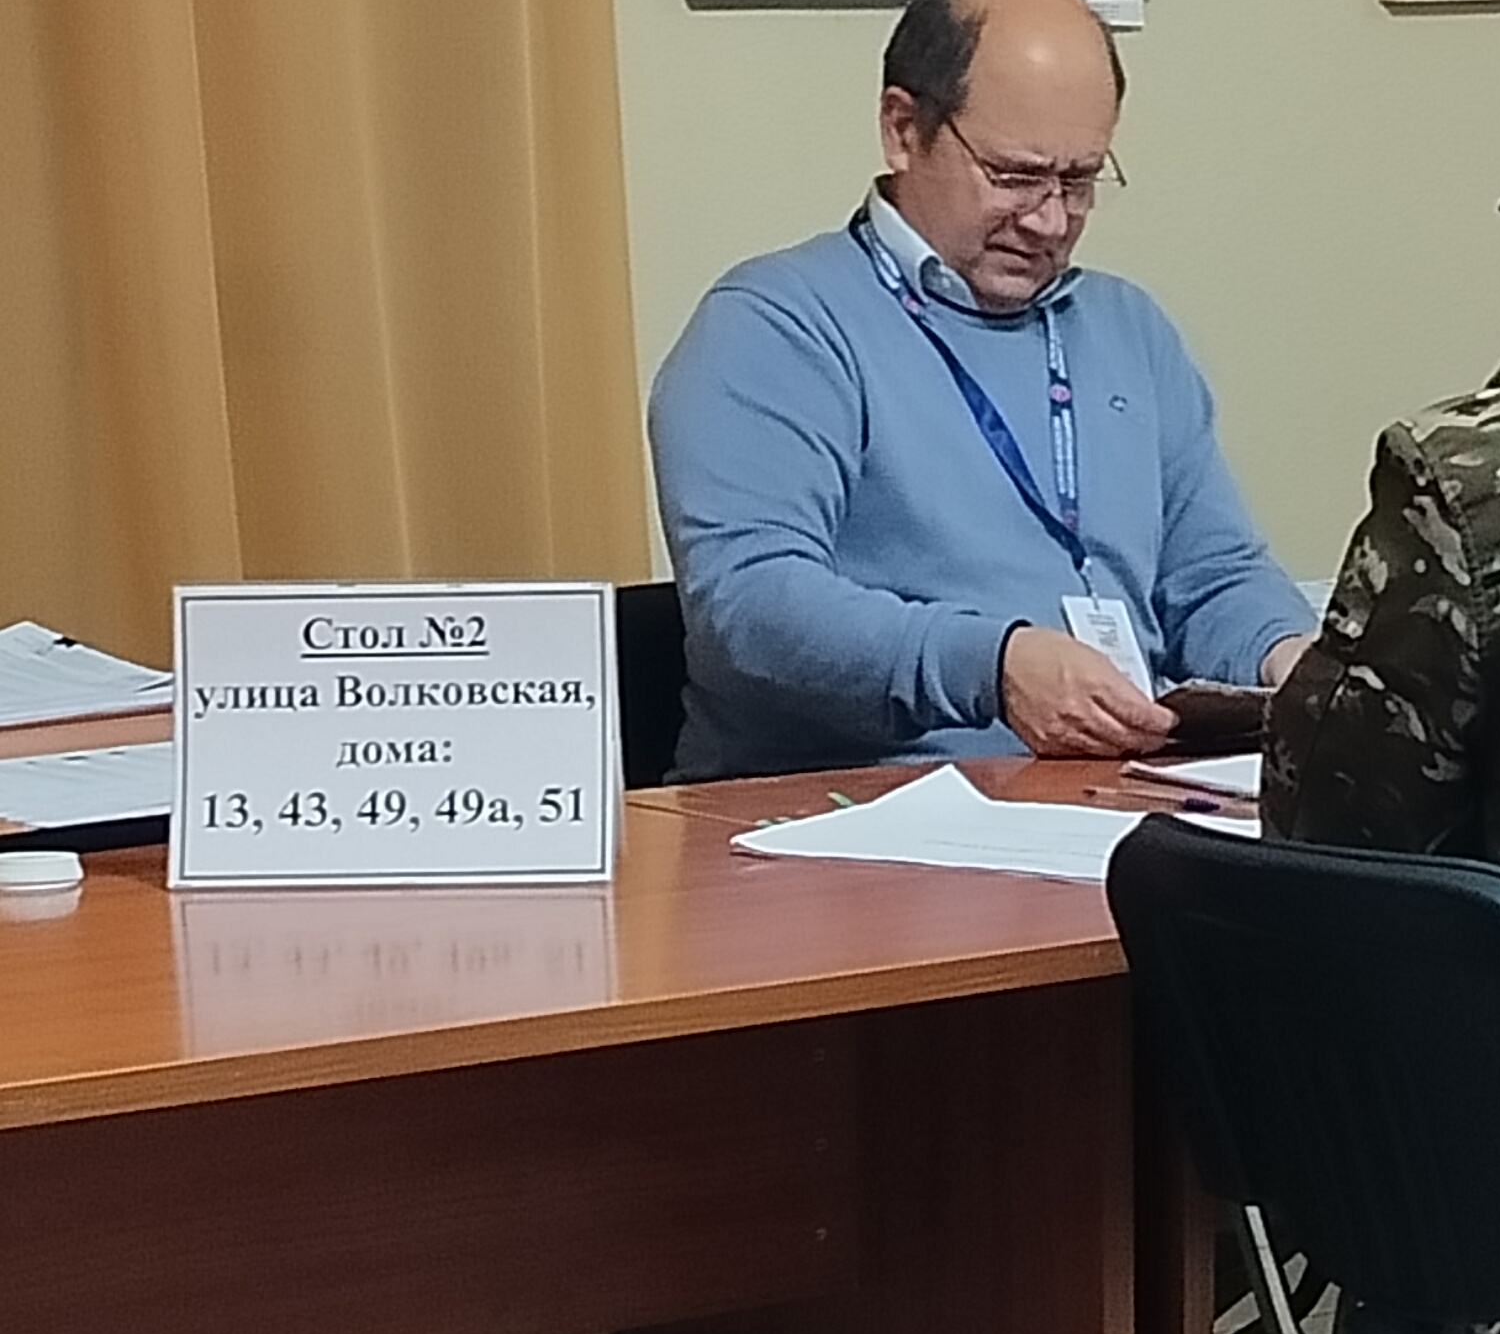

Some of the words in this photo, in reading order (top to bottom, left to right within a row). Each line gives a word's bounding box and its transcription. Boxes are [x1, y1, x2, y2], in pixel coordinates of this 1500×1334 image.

[301, 616, 406, 651] Стол
[417, 615, 488, 647] №2
[193, 684, 321, 719] улица
[335, 674, 596, 711] Волковская,
[335, 739, 453, 769] дома:
[203, 792, 265, 835] 13,
[277, 791, 343, 833] 43,
[355, 789, 421, 832] 49,
[434, 788, 524, 830] 49а,
[538, 786, 585, 824] 51
